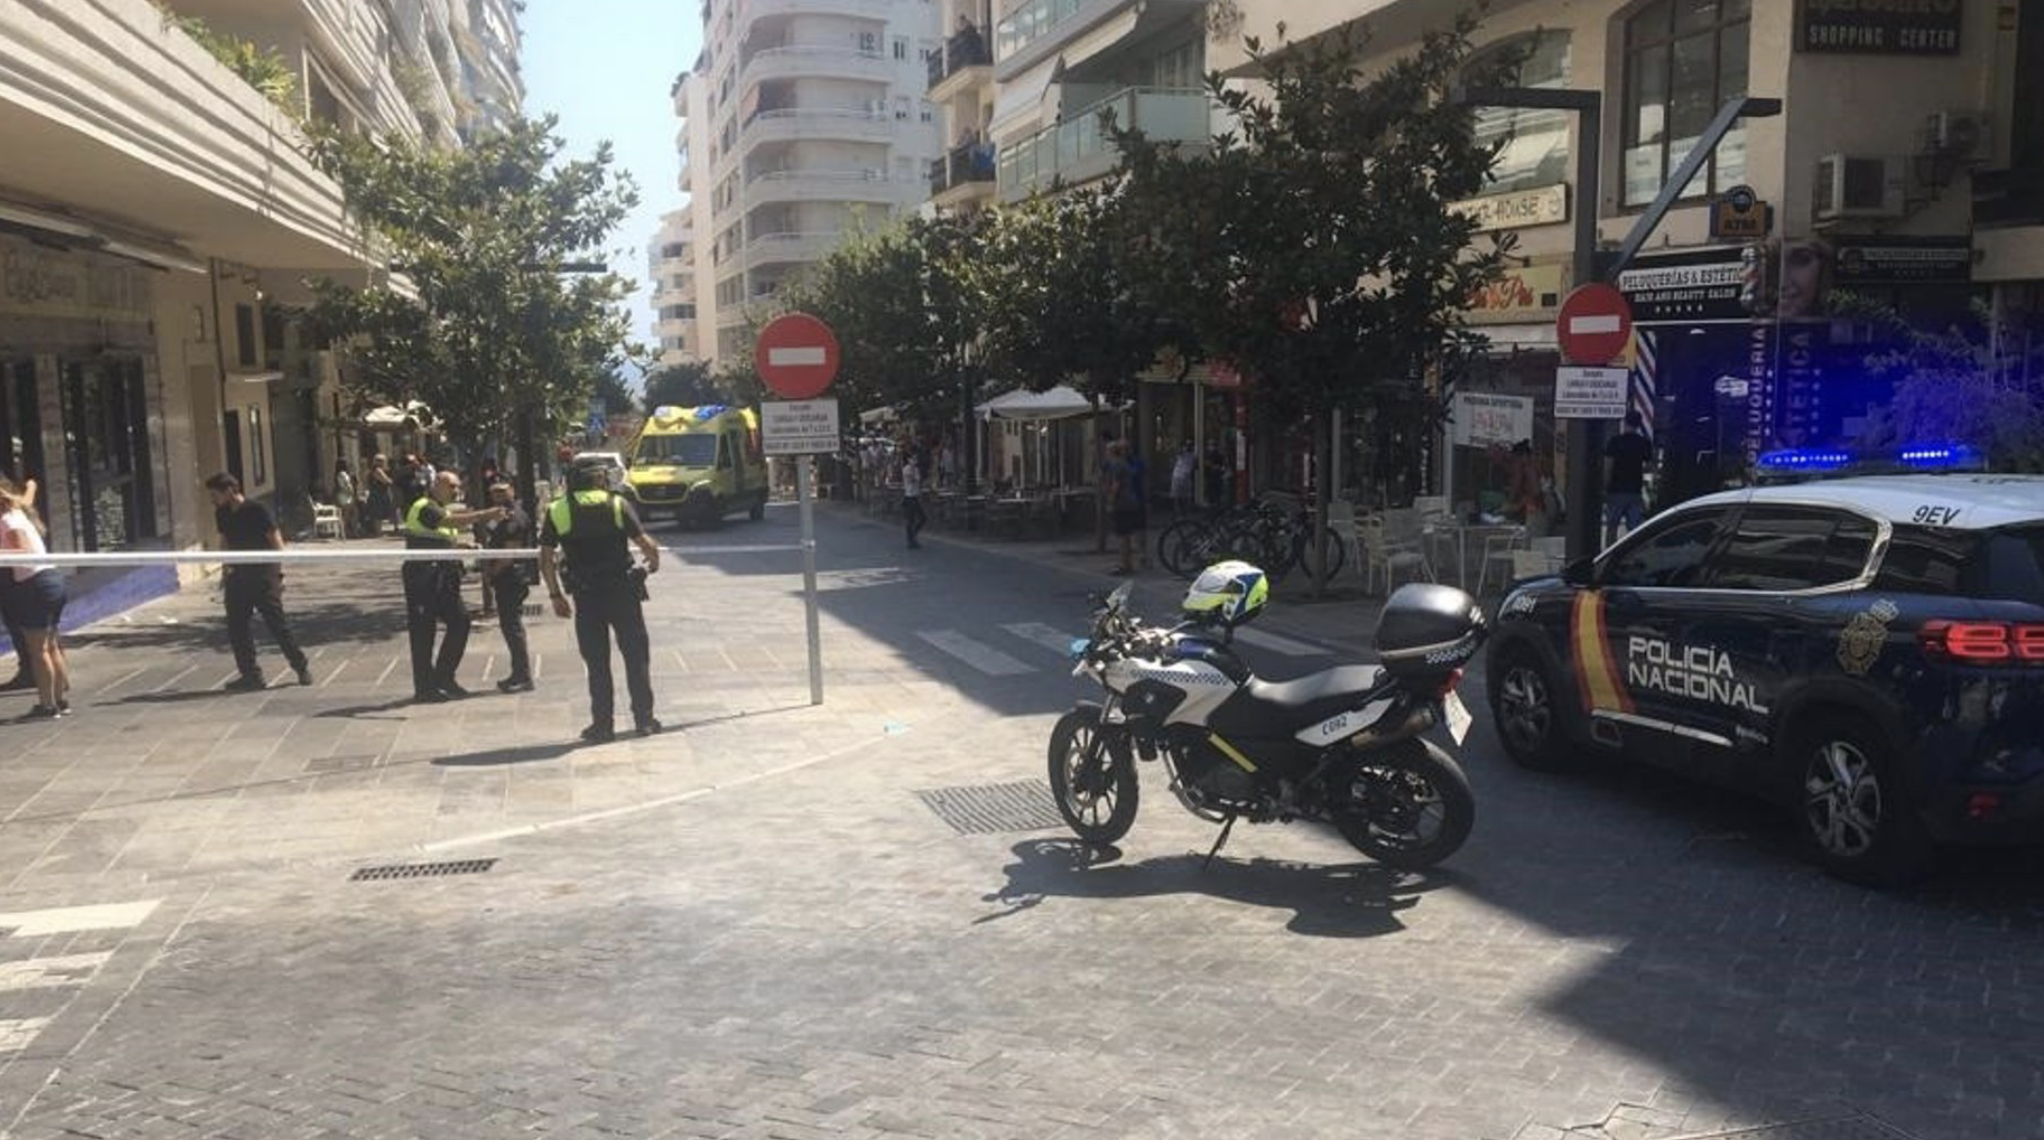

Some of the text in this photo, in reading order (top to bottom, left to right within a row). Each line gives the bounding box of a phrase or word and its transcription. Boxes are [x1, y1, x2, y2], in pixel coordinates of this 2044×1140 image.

[1809, 25, 1956, 49] SHOPPING CENTER
[1912, 505, 1961, 525] 9EV
[1629, 636, 1735, 679] POLICÍA
[1629, 661, 1769, 714] NACIONAL
